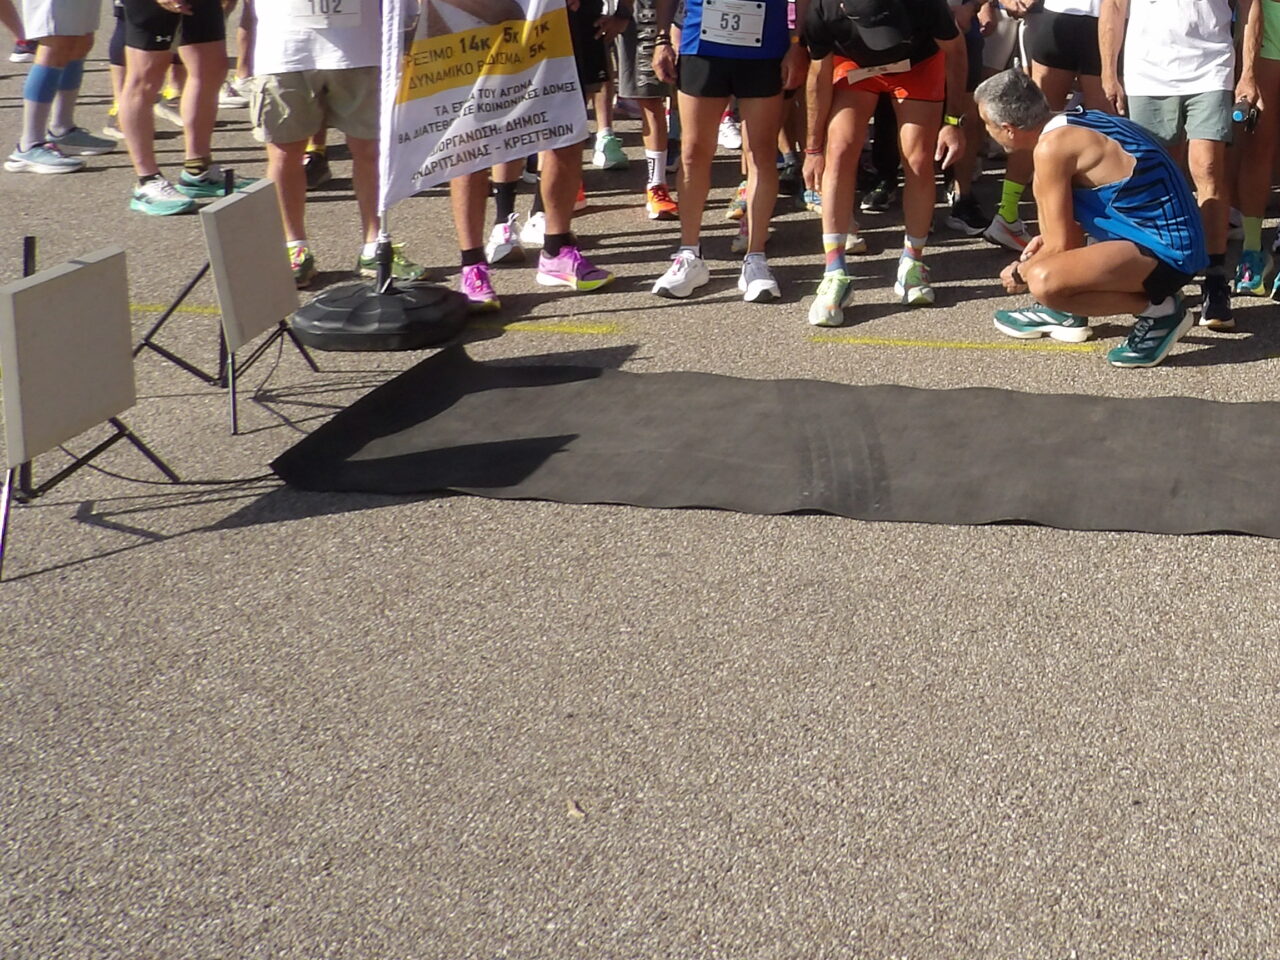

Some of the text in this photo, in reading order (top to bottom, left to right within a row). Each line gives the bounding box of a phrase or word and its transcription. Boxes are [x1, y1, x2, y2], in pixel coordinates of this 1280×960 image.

[720, 13, 741, 31] 53
[408, 62, 474, 90] ΔΥΝΑΜΙΚΟ
[477, 88, 498, 100] ΤΟΥ
[542, 81, 577, 95] ΔΟΜΕΣ
[505, 111, 549, 132] ΔΗΜΟΣ
[505, 123, 574, 151] ΚΡΕΣΤΕΝΩΝ
